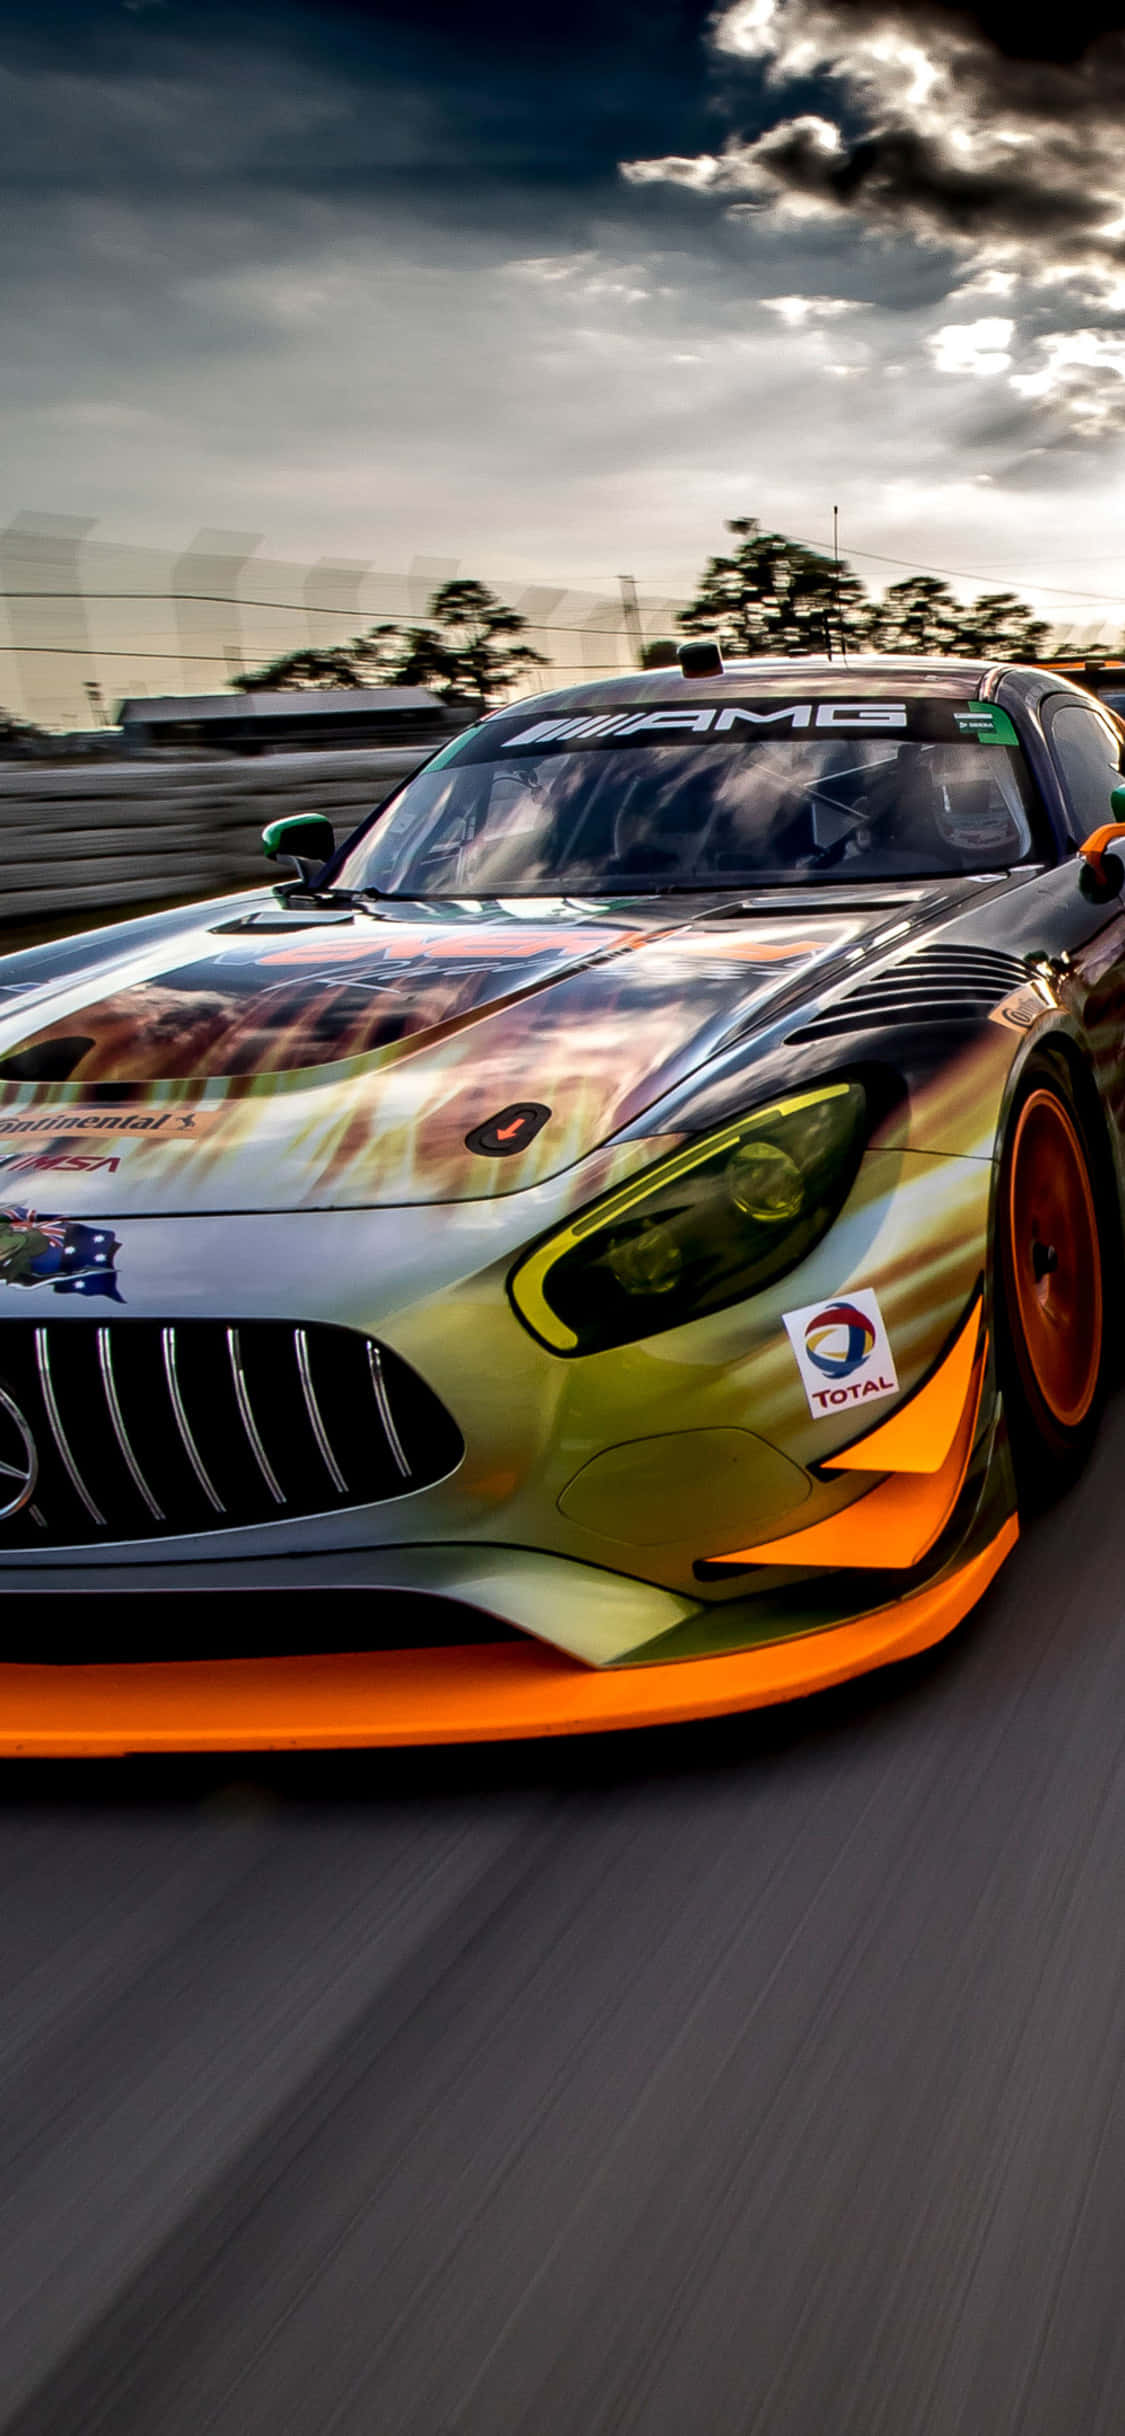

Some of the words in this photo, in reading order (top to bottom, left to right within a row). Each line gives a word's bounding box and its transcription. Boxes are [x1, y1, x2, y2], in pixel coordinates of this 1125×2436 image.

[613, 703, 908, 737] AMG
[0, 1113, 172, 1134] ontinental
[7, 1155, 121, 1174] IMSA
[811, 1376, 895, 1409] TOTAL
